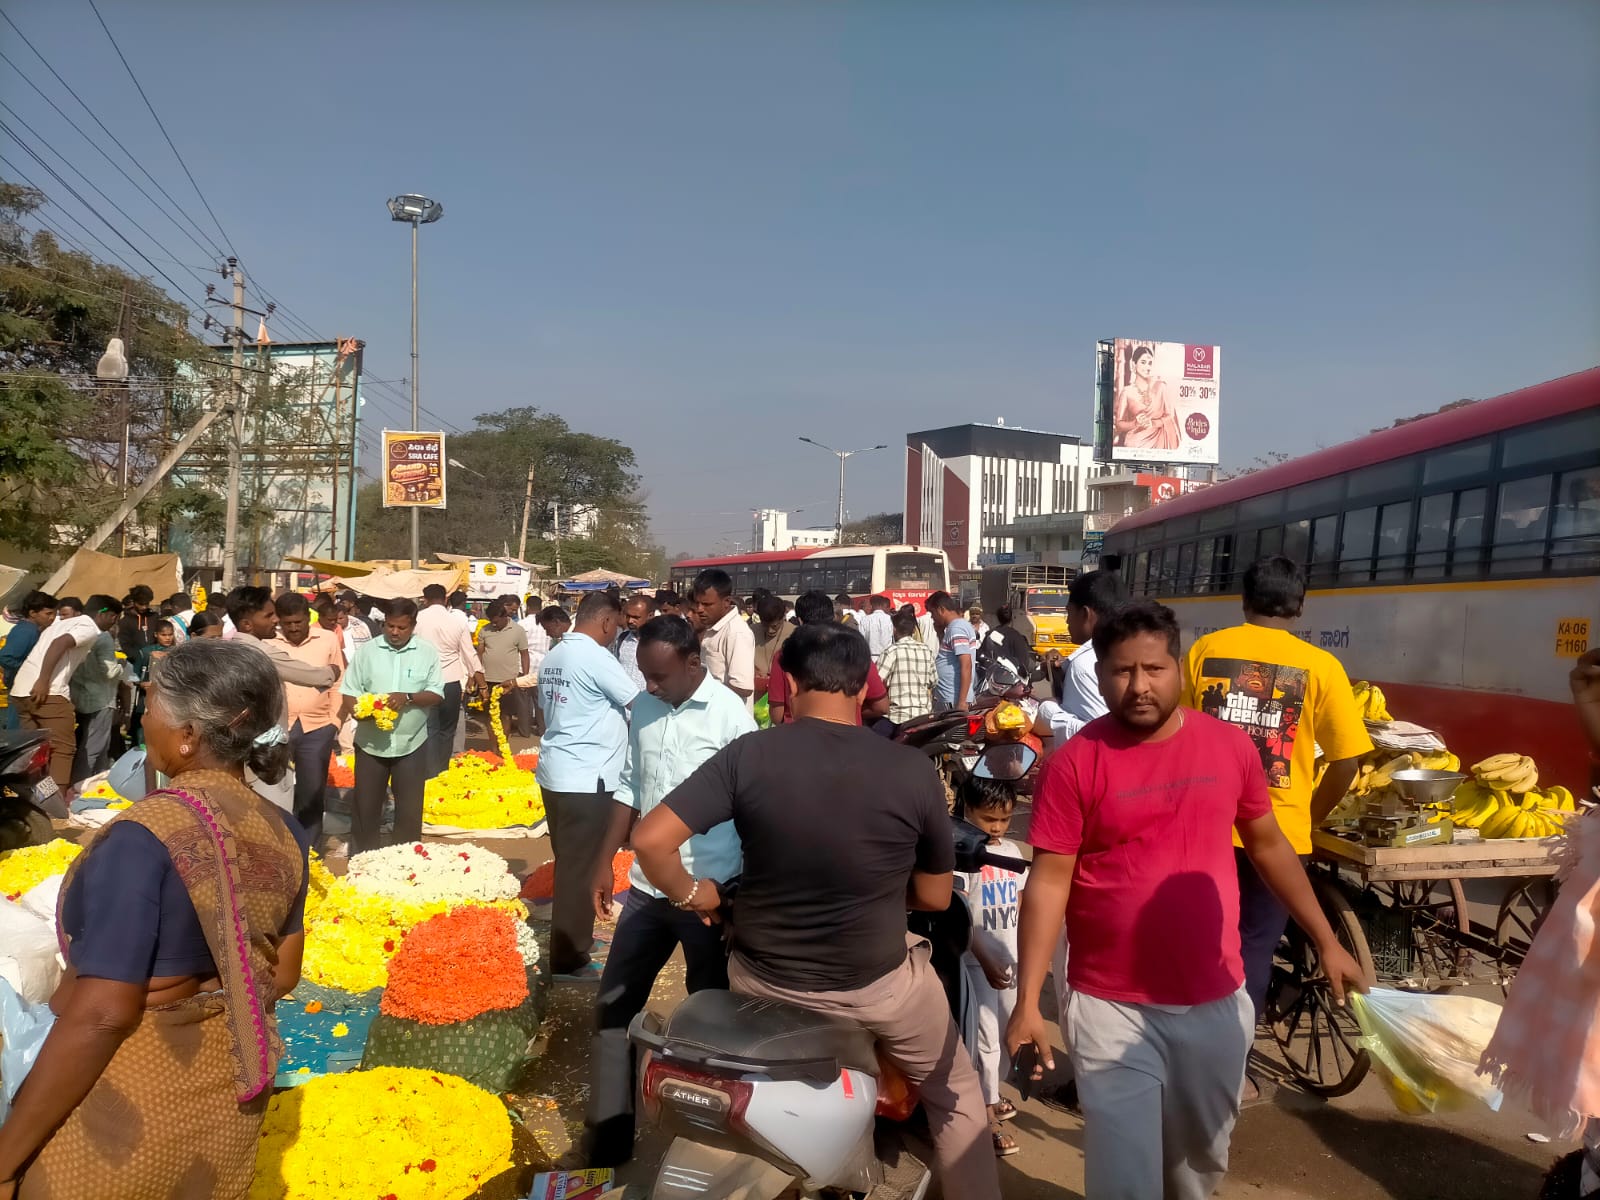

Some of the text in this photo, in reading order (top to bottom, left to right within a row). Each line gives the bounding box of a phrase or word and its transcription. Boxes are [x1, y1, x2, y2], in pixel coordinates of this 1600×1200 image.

[1573, 623, 1587, 635] 06
[1565, 639, 1587, 653] 1160
[1226, 691, 1259, 711] the
[1218, 706, 1282, 728] weeknd
[1248, 726, 1278, 739] HOURS
[982, 881, 1017, 906] NYC
[982, 906, 1018, 931] NYC
[673, 1091, 710, 1106] ATHER
